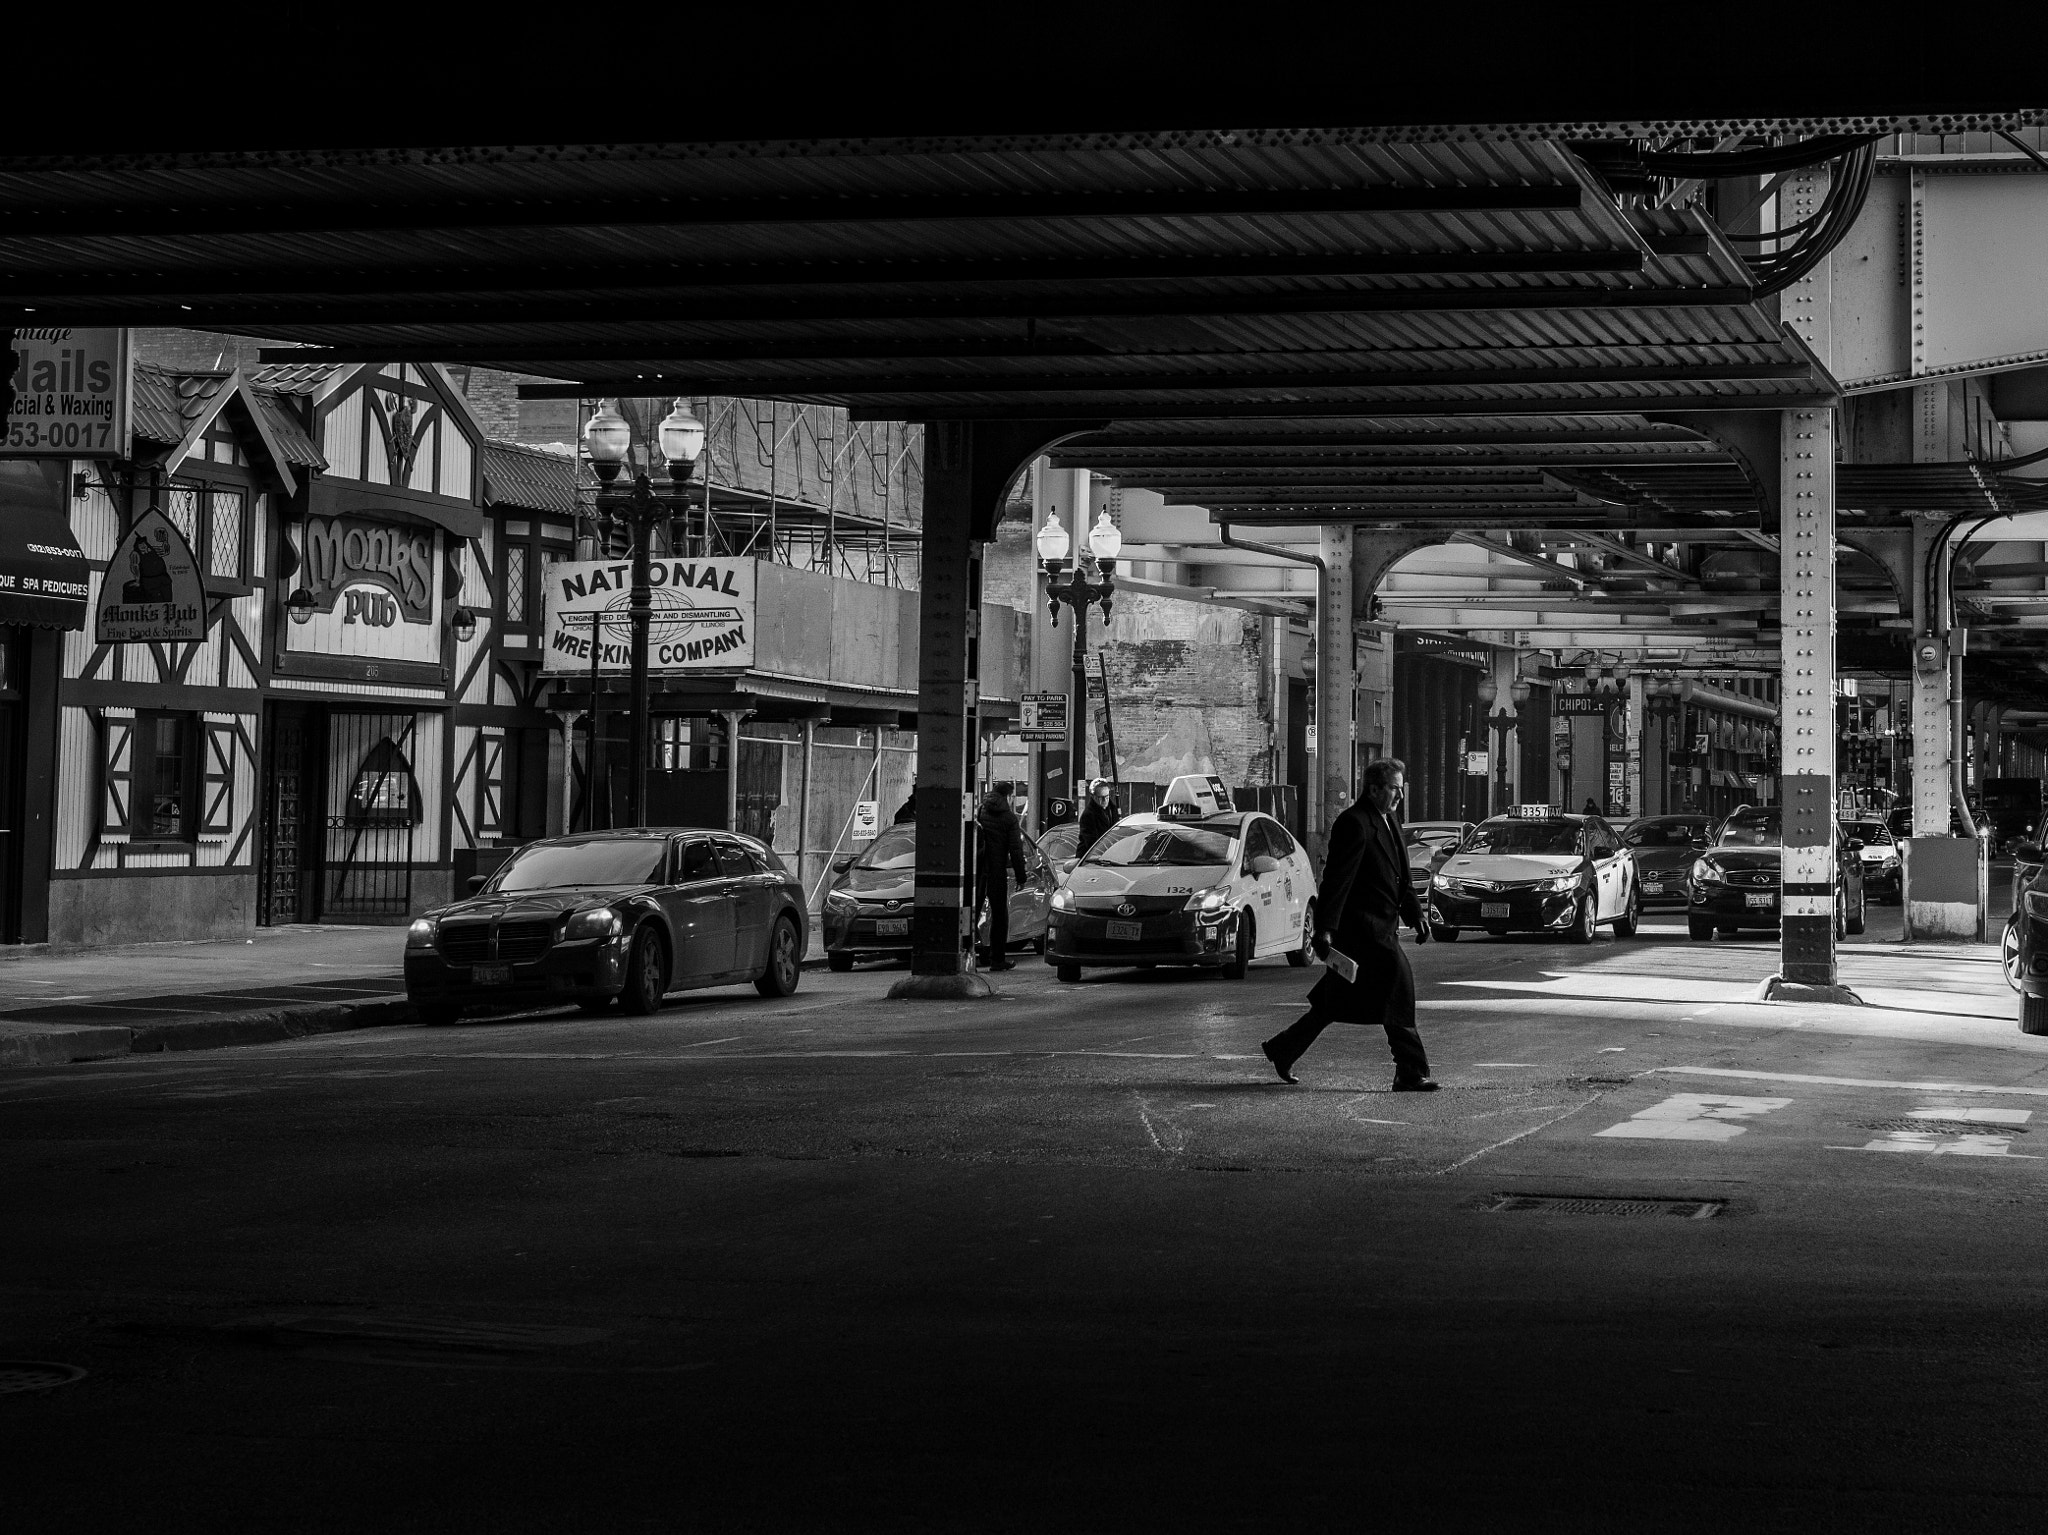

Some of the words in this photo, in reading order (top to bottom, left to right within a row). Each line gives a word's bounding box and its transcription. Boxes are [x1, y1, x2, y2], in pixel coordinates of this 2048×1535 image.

[14, 328, 72, 345] mage
[45, 395, 55, 415] &
[61, 395, 113, 421] Waxing
[23, 577, 40, 591] SPA
[42, 579, 89, 596] PEDICURES
[561, 562, 740, 602] NATONAL
[102, 603, 159, 627] Monk's
[162, 603, 198, 628] Pub
[568, 614, 614, 622] ENGINERED
[681, 611, 731, 619] DISMANTLING
[107, 628, 127, 639] Fine
[129, 628, 151, 640] Food
[152, 629, 160, 638] &
[162, 627, 193, 640] Spirits
[552, 629, 633, 665] WRECKIN
[658, 624, 747, 665] COMPANY
[1169, 803, 1190, 815] 1324
[1523, 806, 1547, 817] 3357
[1166, 886, 1194, 894] 1324
